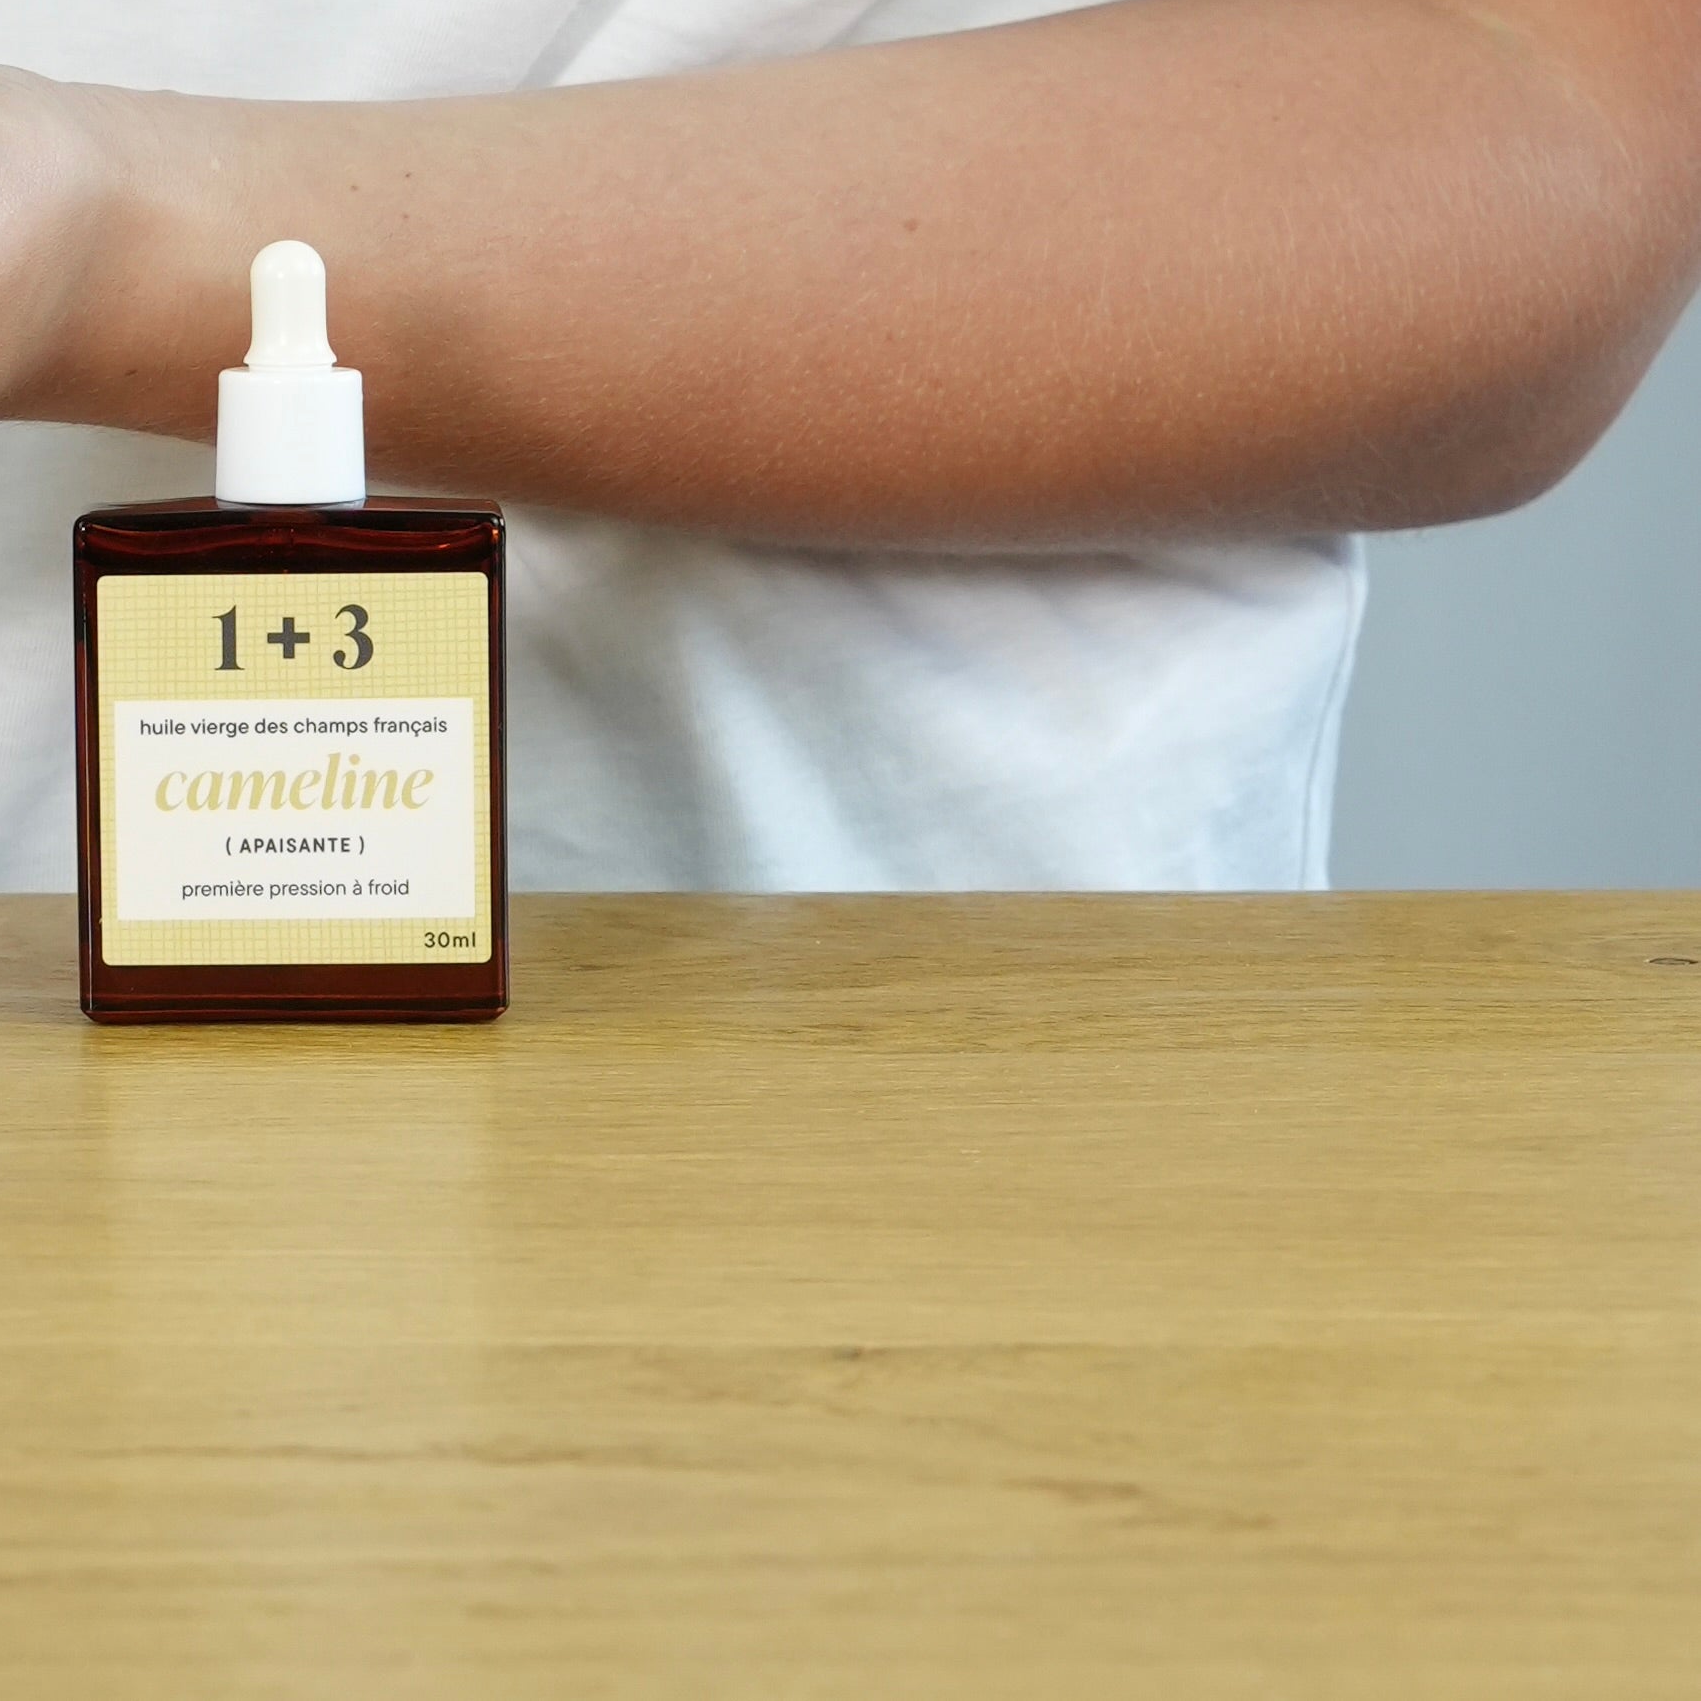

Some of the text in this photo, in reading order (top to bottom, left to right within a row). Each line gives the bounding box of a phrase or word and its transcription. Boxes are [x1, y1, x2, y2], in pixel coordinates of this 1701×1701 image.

[212, 605, 245, 671] 1
[333, 604, 375, 671] 3
[140, 717, 448, 738] huile vierge des champs français
[155, 752, 435, 812] cameline
[239, 838, 351, 854] APAISANTE
[182, 879, 410, 900] première pression à froid
[424, 932, 477, 948] 30ml
